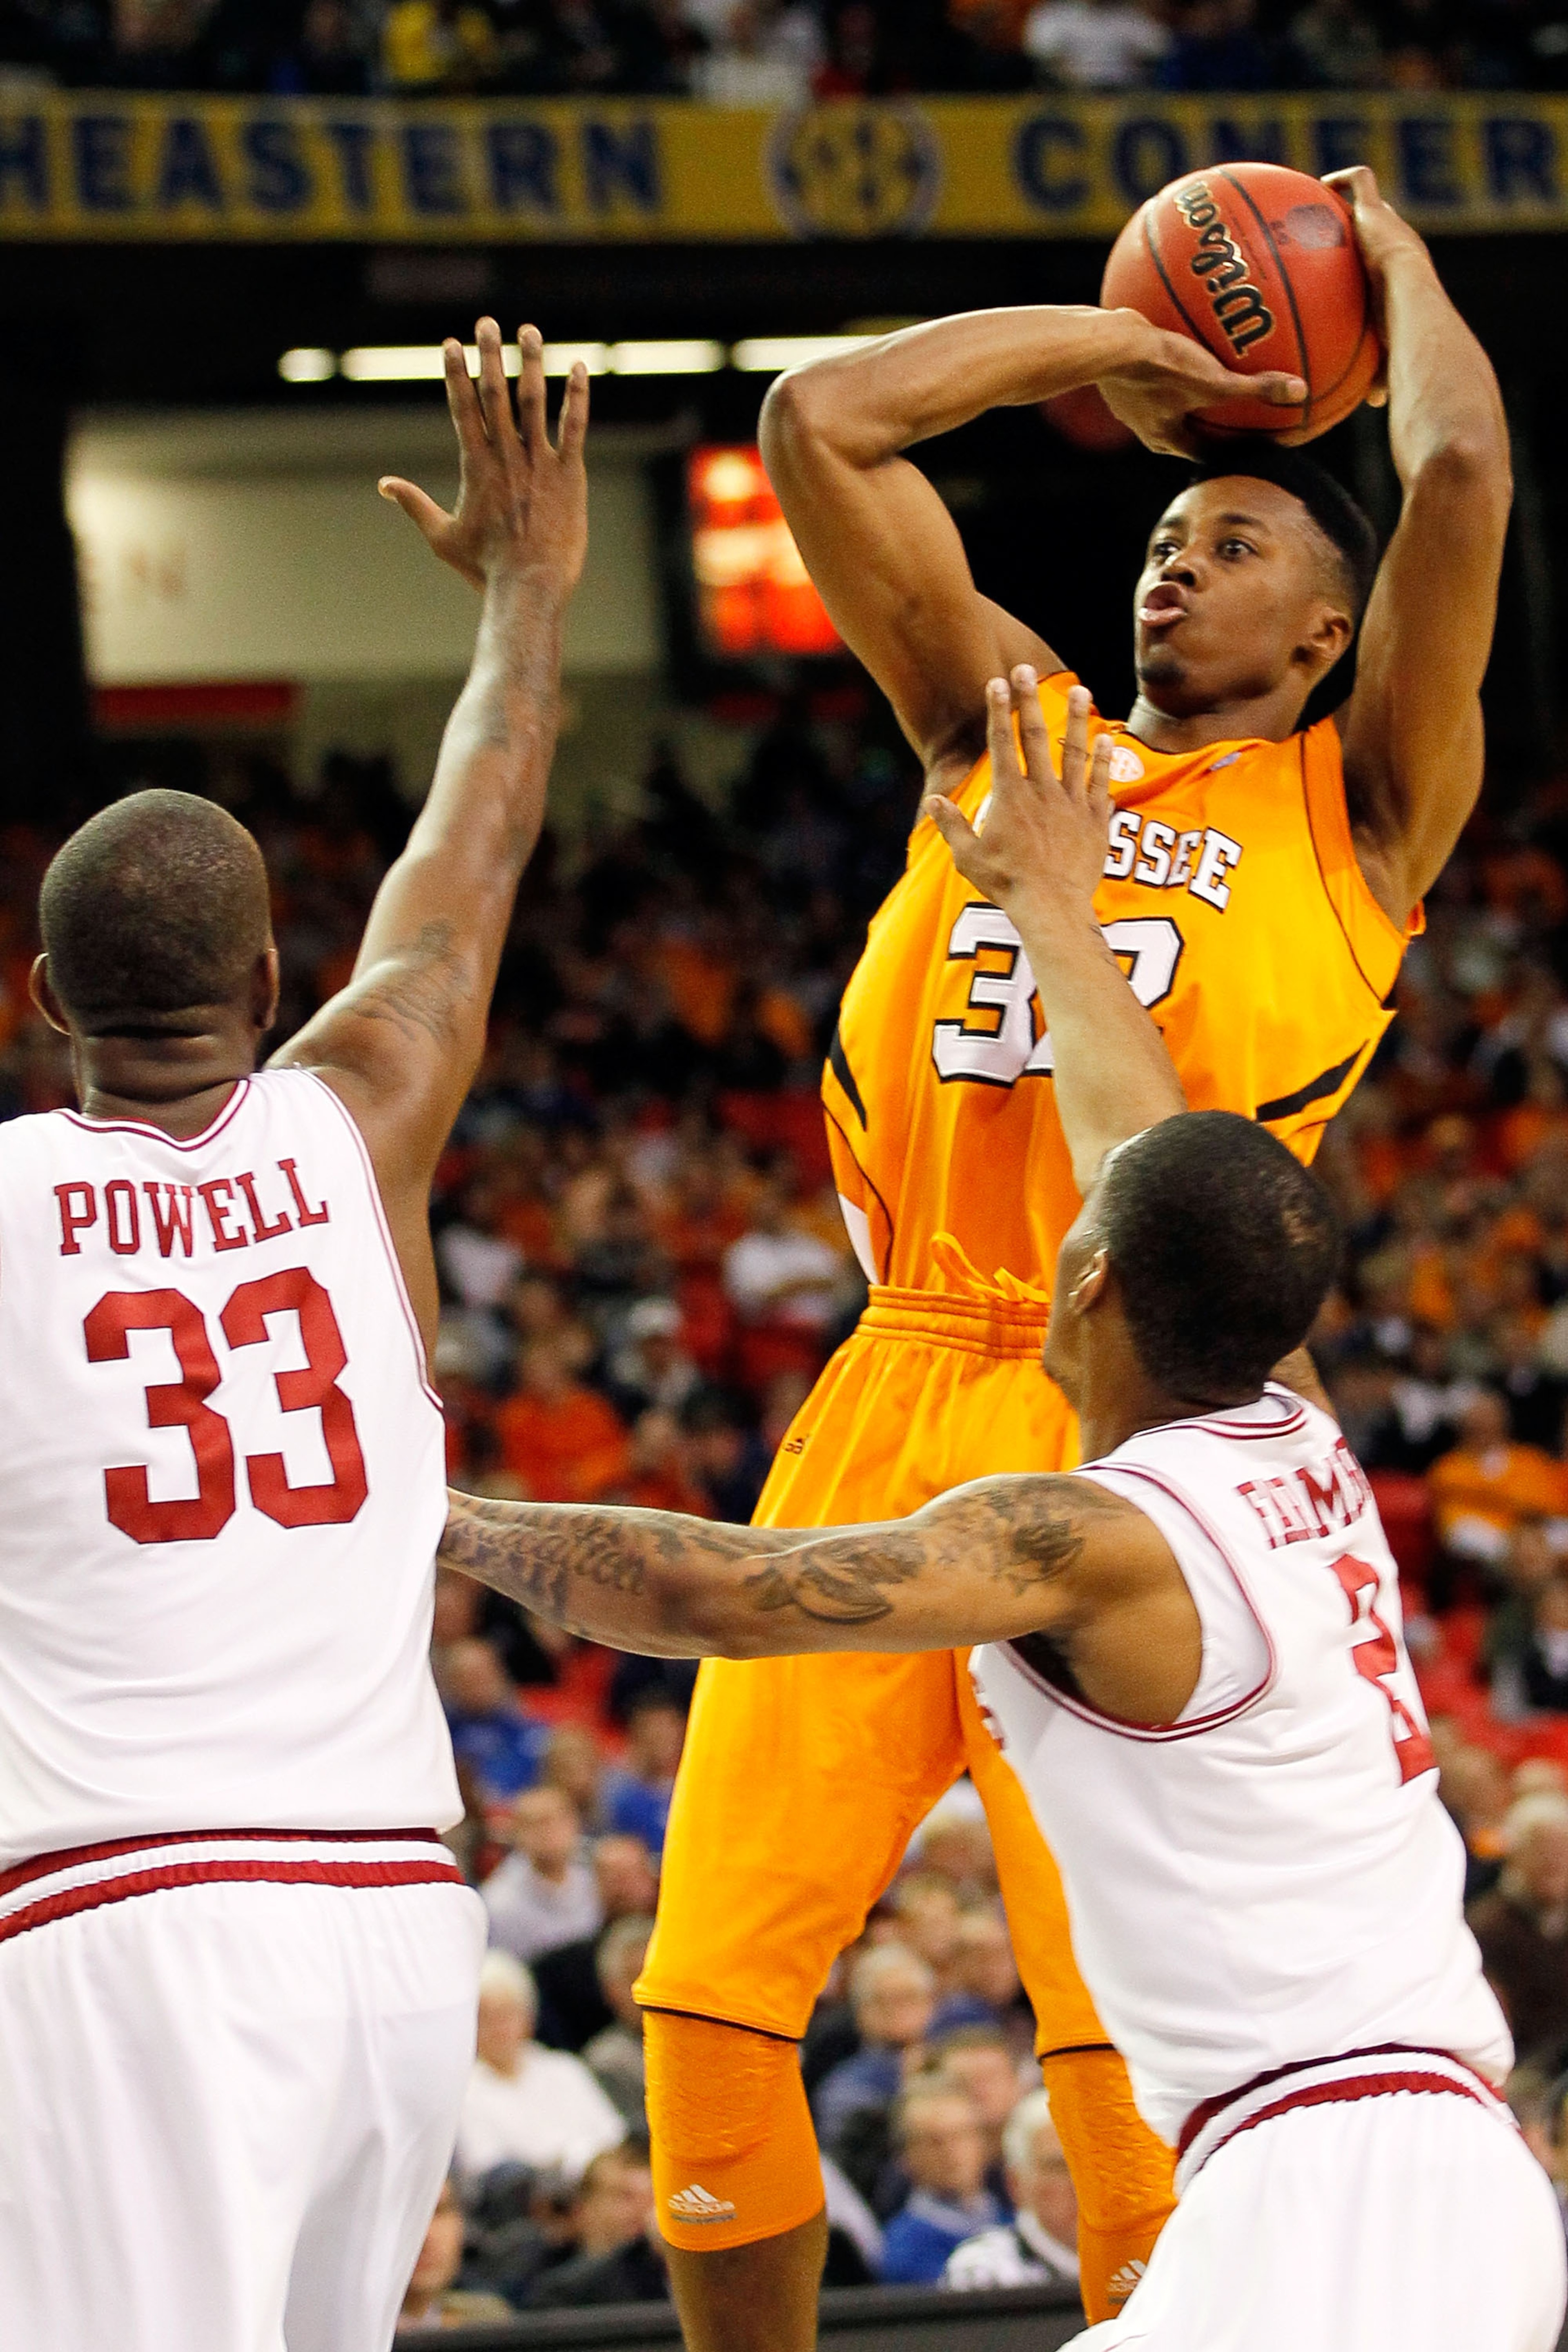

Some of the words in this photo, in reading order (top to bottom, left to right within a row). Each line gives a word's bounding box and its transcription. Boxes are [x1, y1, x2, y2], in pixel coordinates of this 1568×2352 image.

[1174, 180, 1276, 359] Wilson
[53, 1158, 330, 1258] POWELL
[82, 1266, 369, 1545] 33
